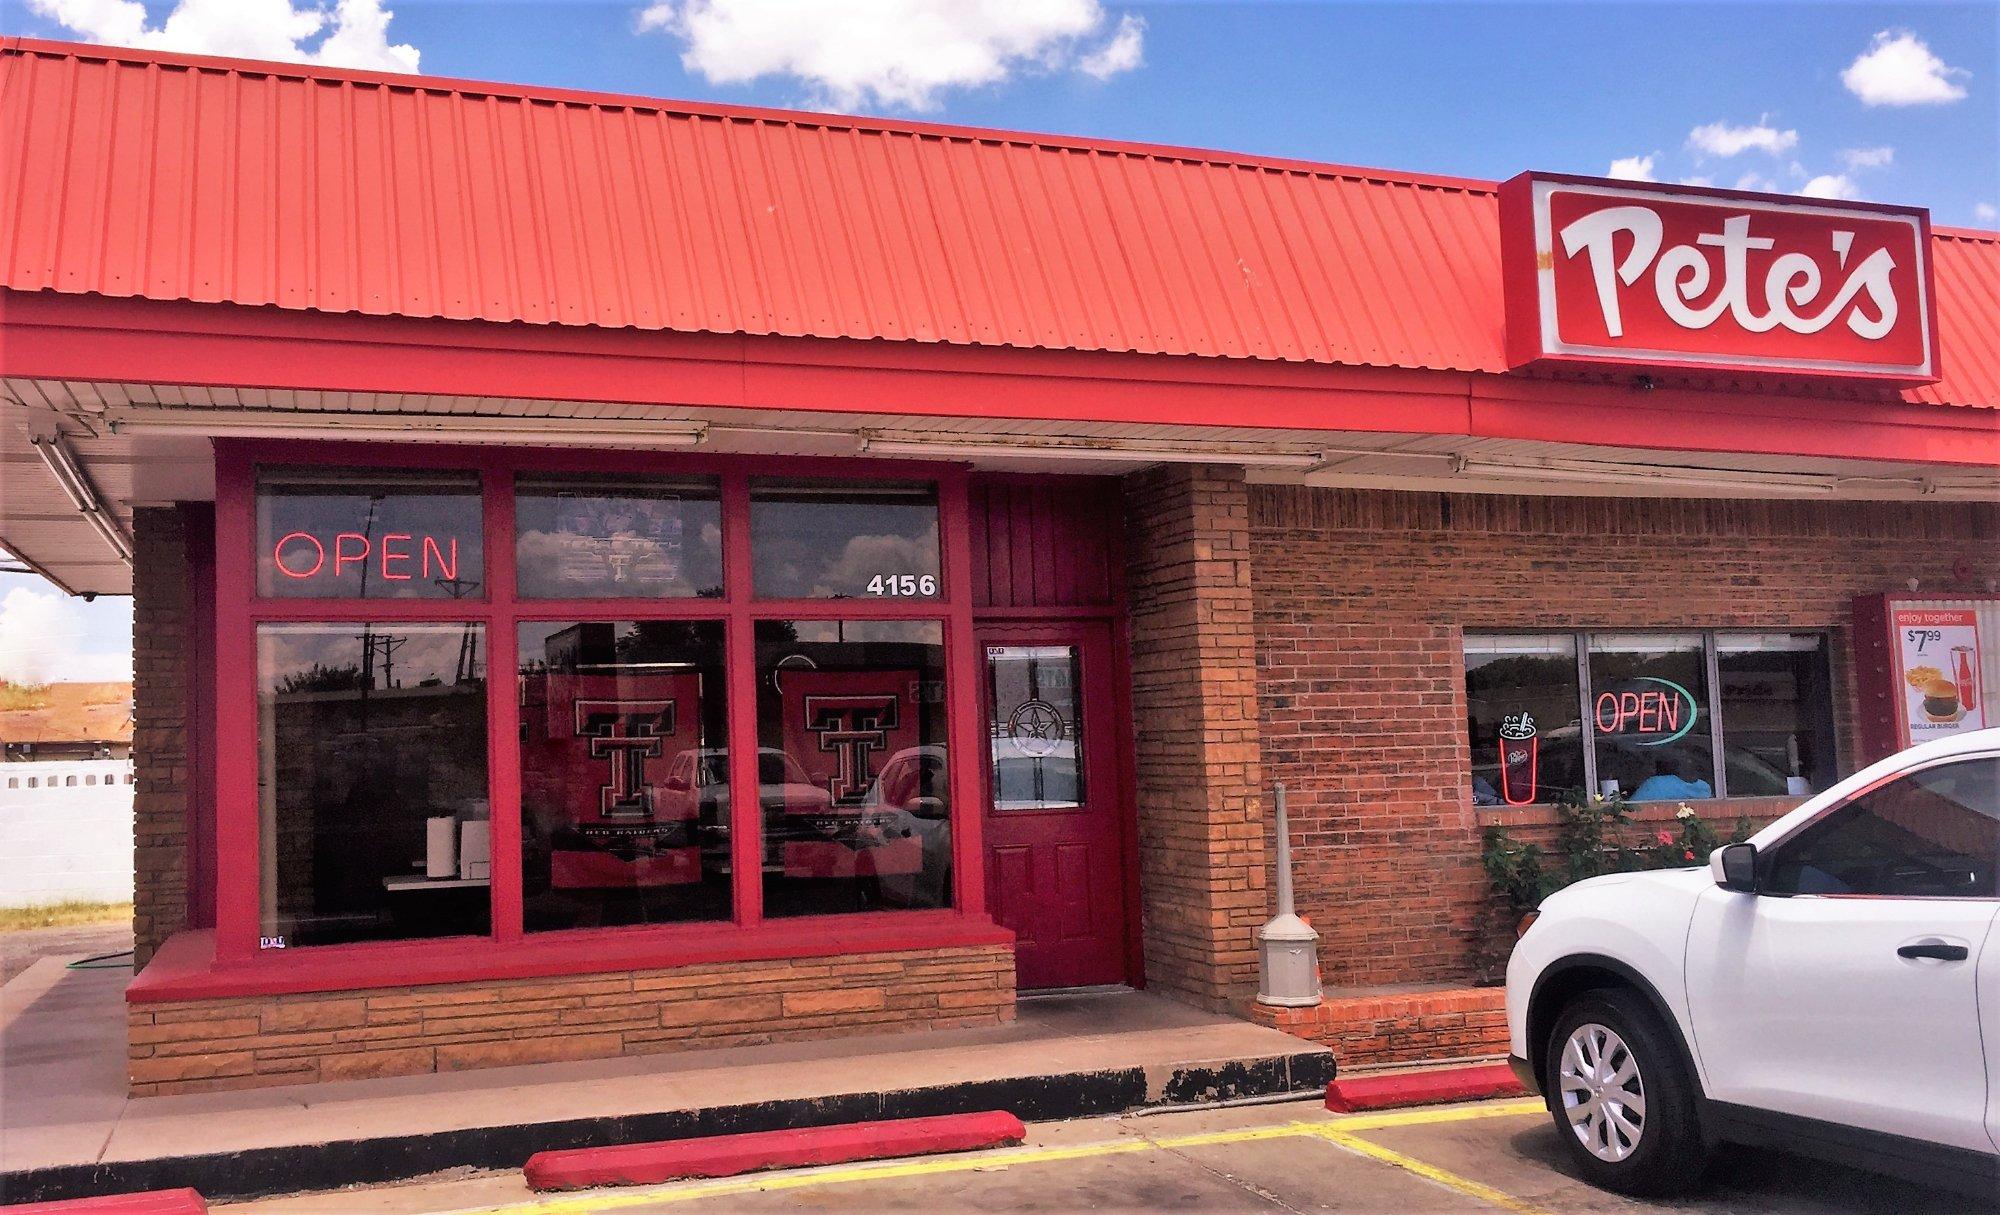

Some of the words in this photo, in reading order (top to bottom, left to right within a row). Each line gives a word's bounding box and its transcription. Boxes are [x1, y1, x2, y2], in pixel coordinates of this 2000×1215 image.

[1559, 205, 1899, 340] Pete's
[274, 531, 458, 581] OPEN
[866, 573, 937, 597] 4156
[1898, 612, 1922, 624] enjoy
[1924, 612, 1963, 624] together
[1595, 691, 1680, 734] OPEN
